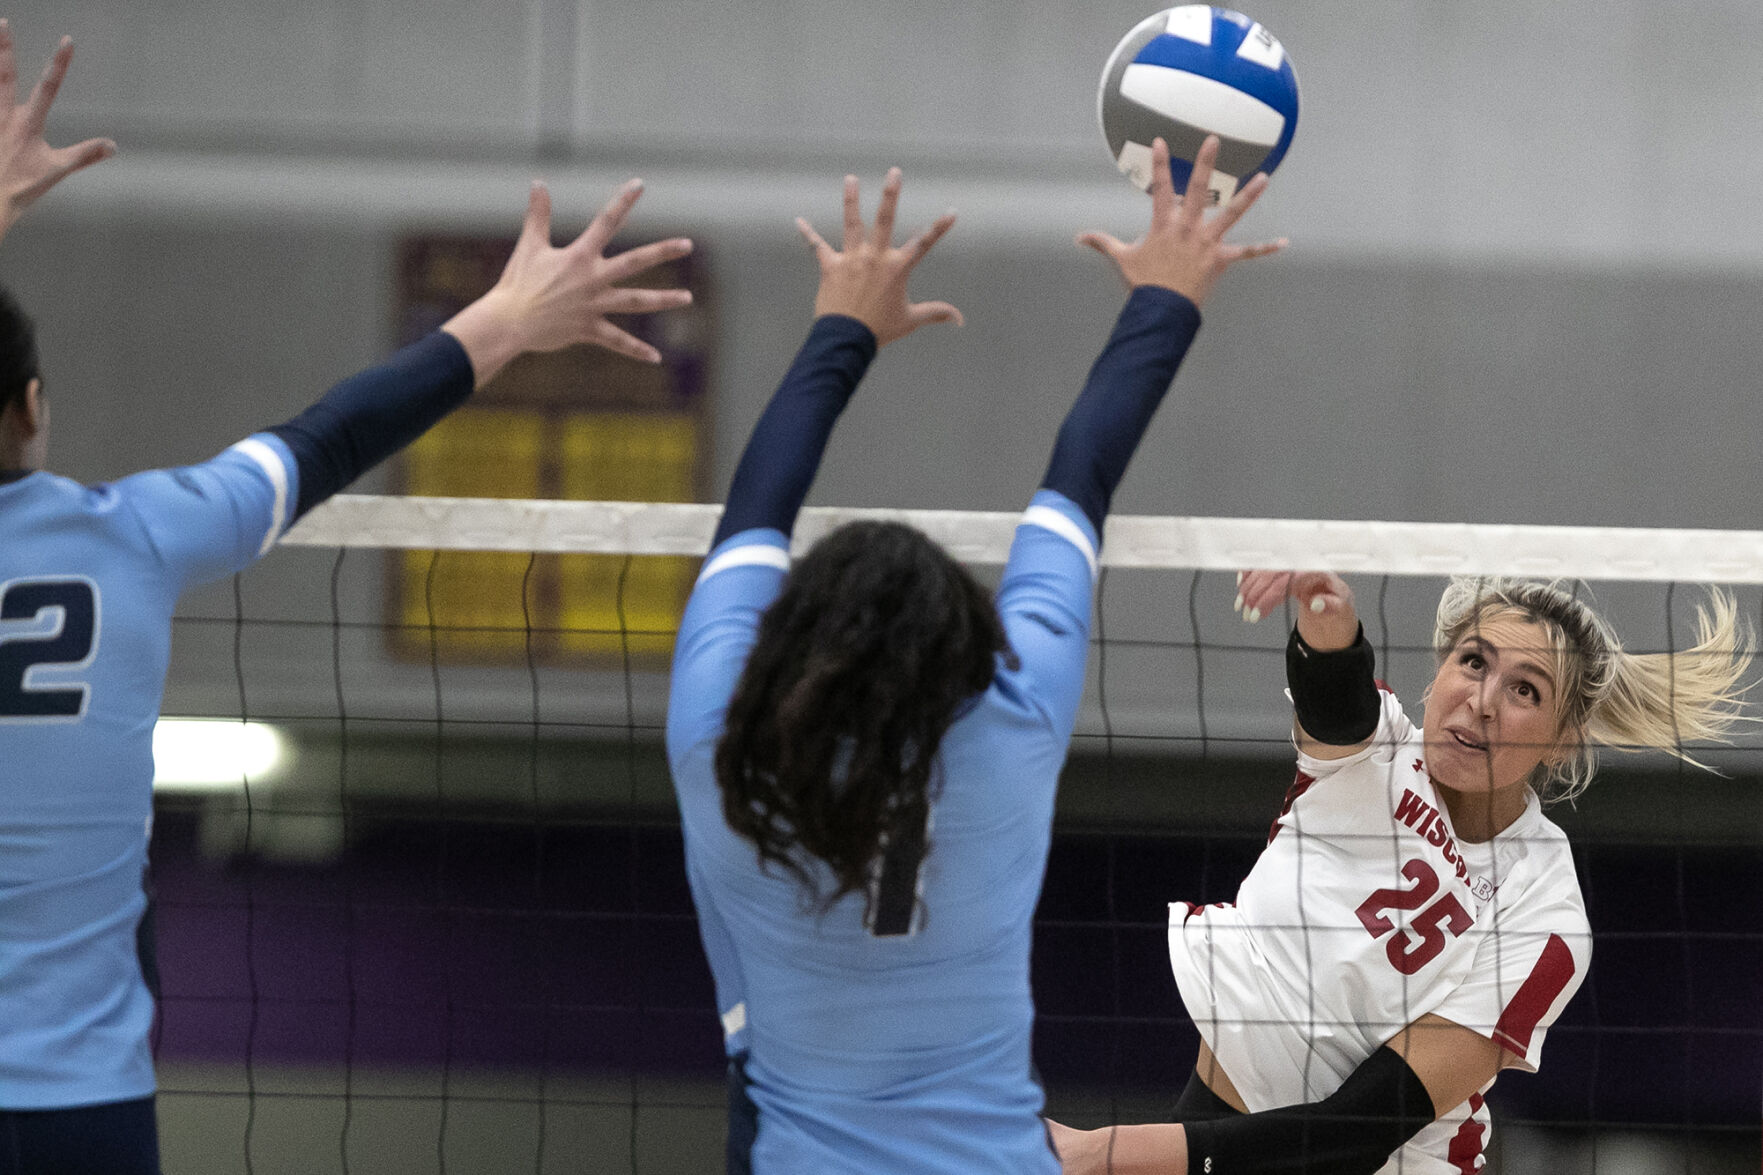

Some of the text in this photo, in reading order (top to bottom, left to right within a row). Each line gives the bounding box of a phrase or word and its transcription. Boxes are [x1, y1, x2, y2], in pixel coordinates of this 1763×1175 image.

[0, 575, 101, 725] 2
[1394, 788, 1472, 888] WISCO
[1354, 858, 1475, 976] 25
